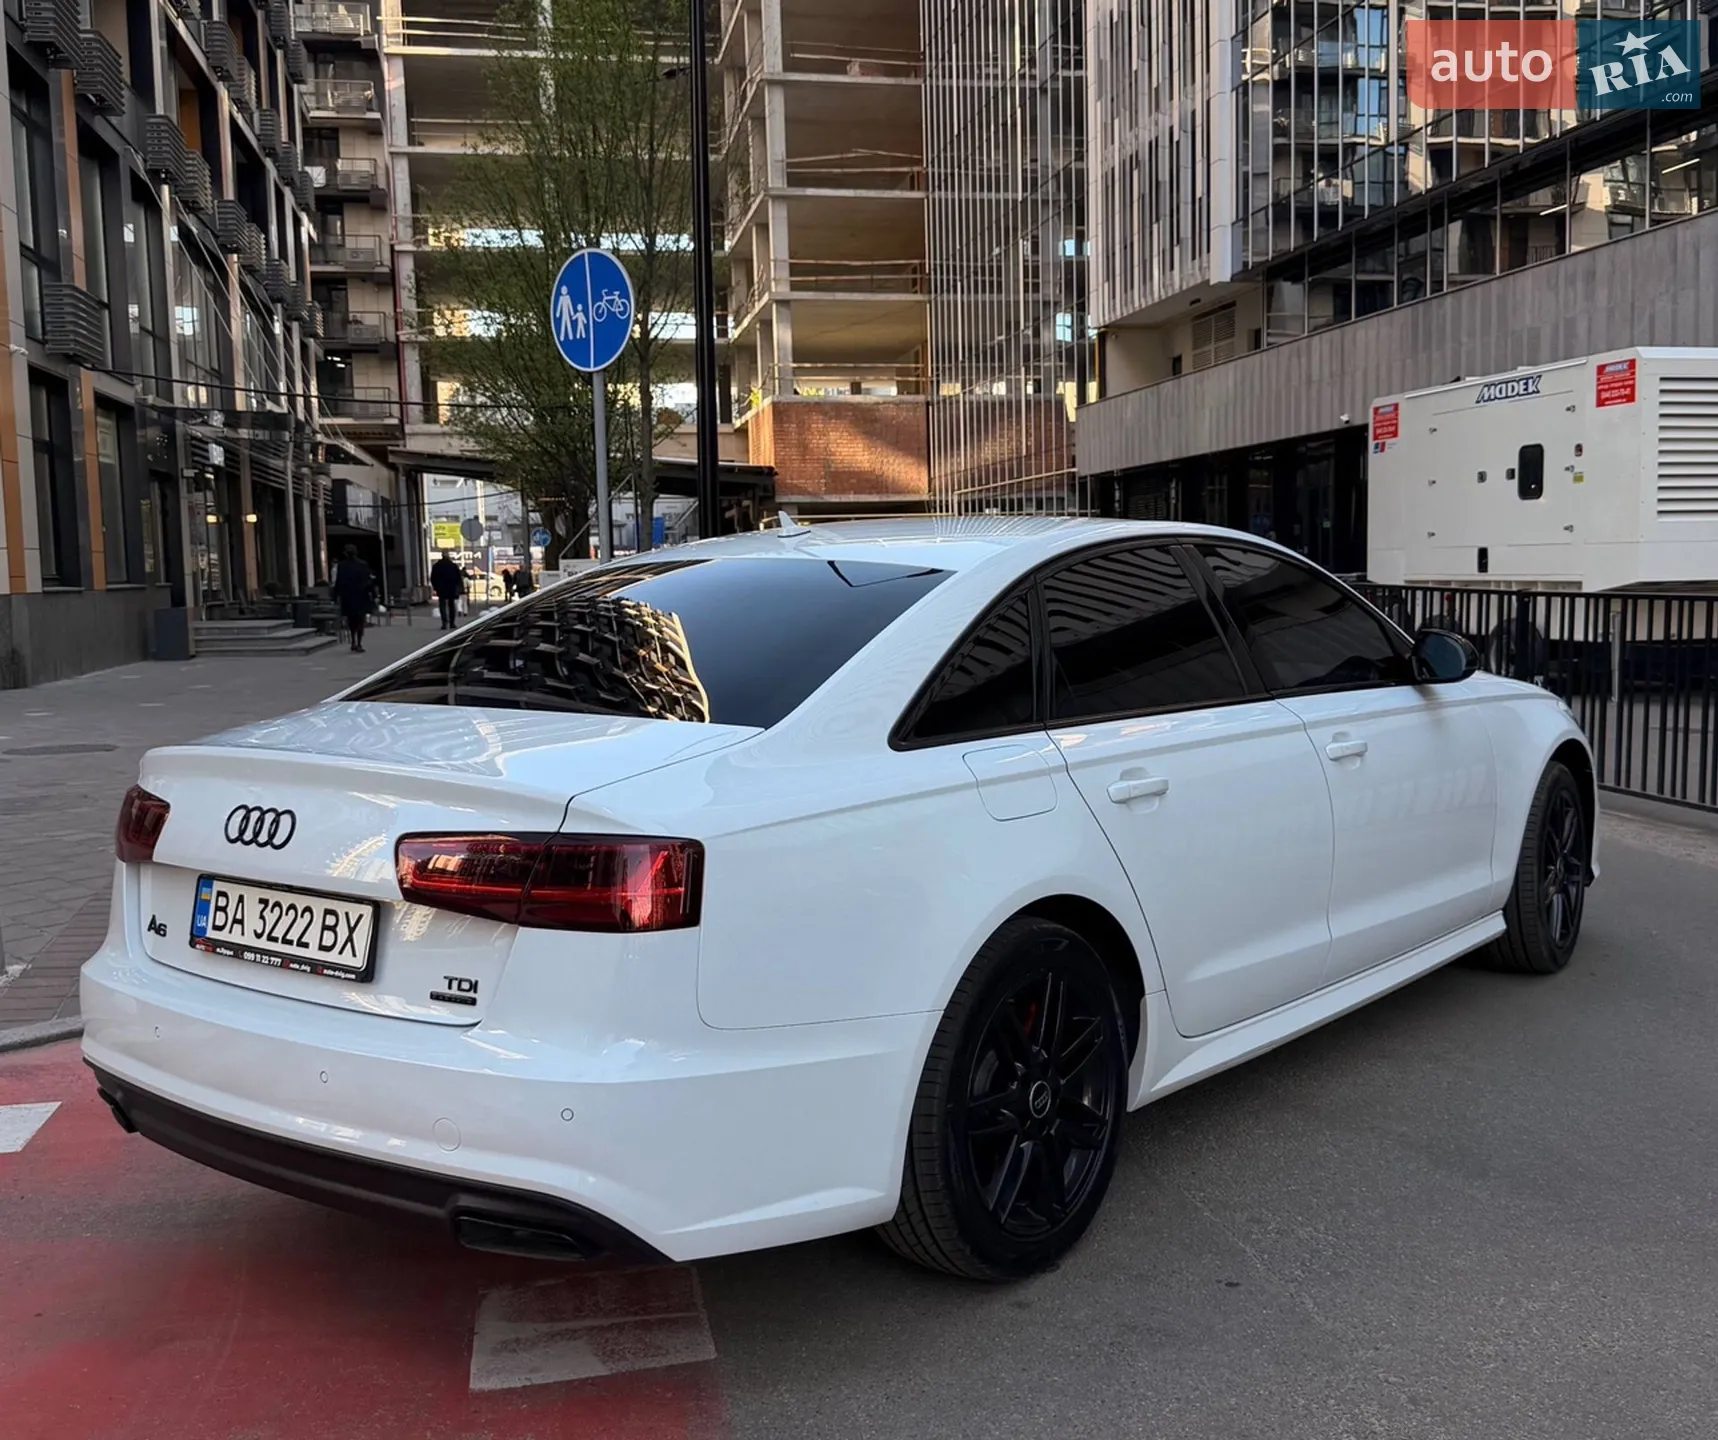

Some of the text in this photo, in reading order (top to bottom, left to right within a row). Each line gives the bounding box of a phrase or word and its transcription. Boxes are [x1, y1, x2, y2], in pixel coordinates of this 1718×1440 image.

[1475, 374, 1542, 404] MADEK
[147, 913, 168, 938] A6
[197, 915, 208, 928] UA
[211, 890, 364, 958] BA 3222 BX
[443, 975, 479, 994] TDI
